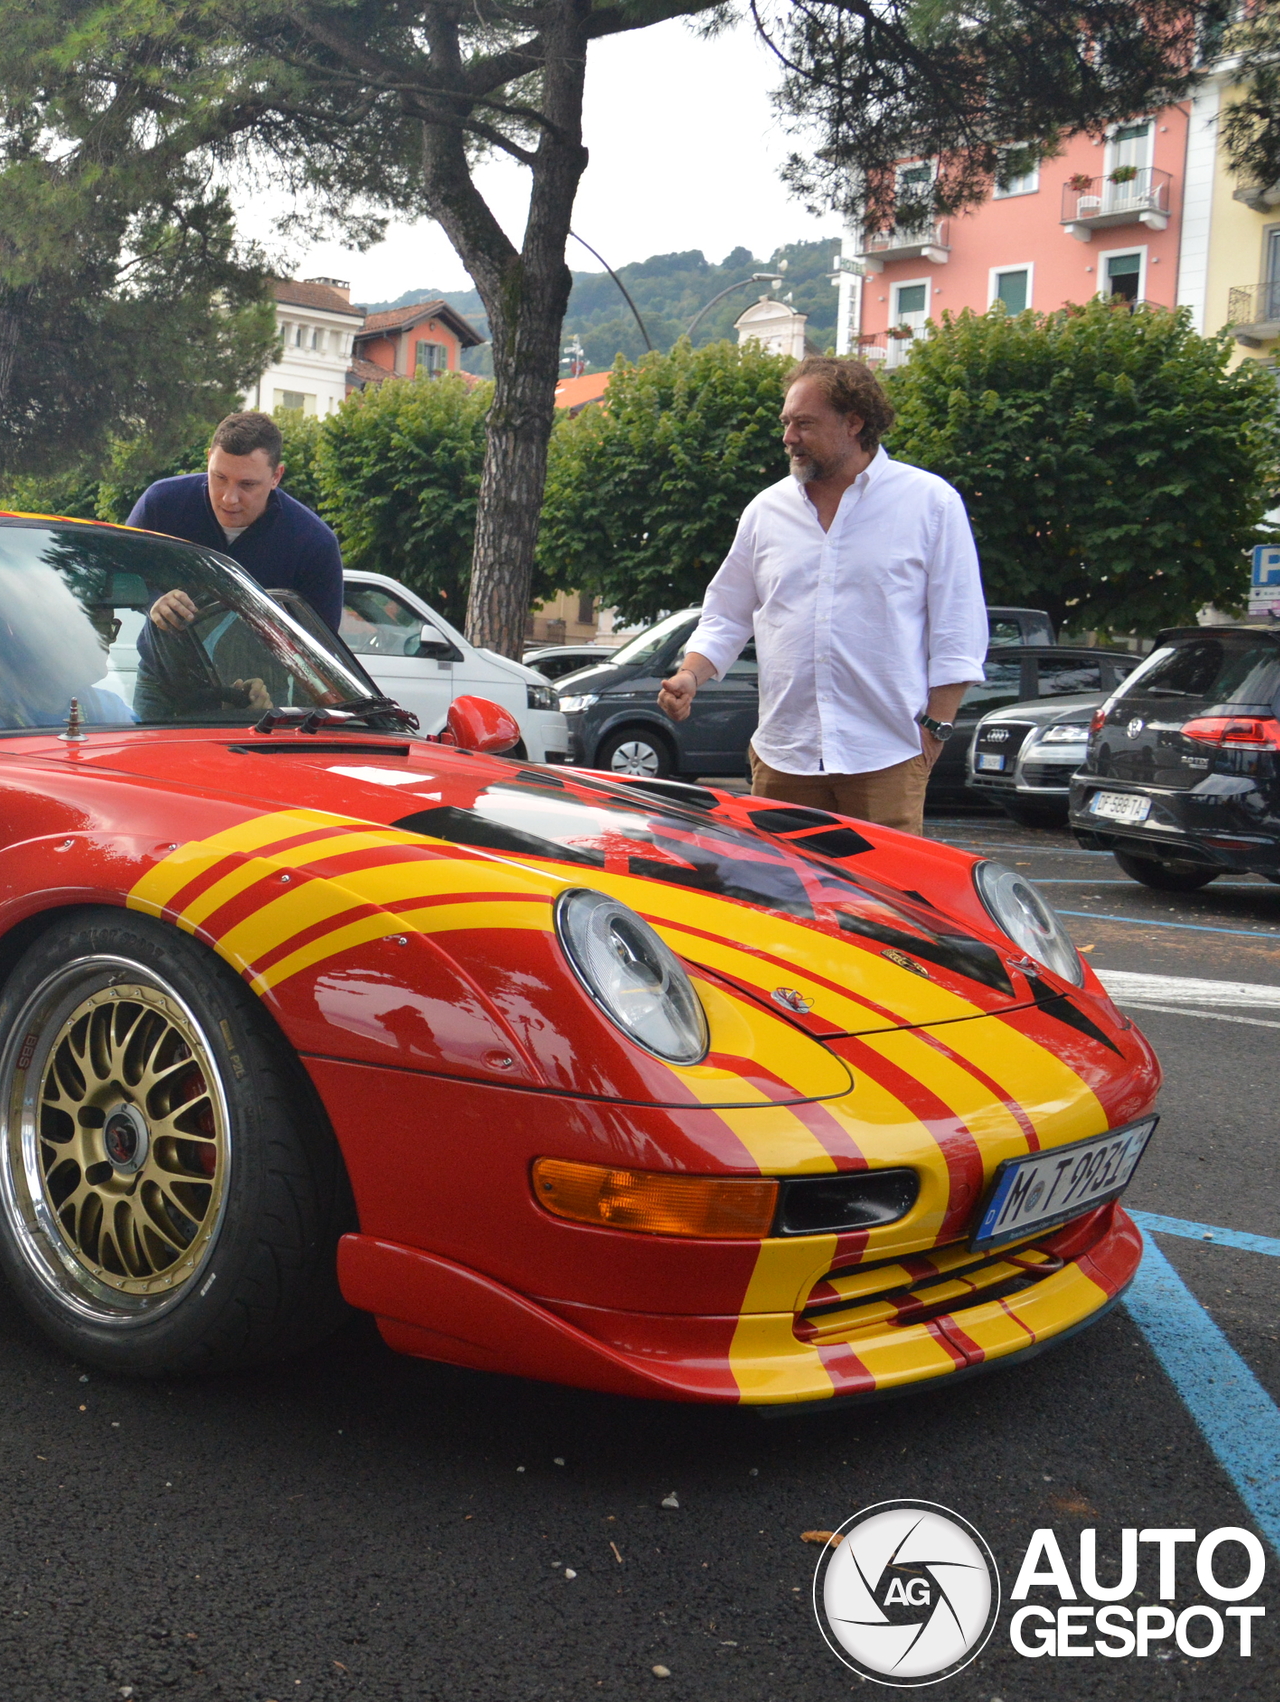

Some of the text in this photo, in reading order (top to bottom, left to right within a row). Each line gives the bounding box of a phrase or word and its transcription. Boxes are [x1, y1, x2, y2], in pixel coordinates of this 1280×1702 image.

[19, 1035, 38, 1069] BBS
[985, 1209, 995, 1225] D
[998, 1167, 1038, 1226] M
[1042, 1156, 1074, 1211] T
[1061, 1135, 1133, 1204] 9931
